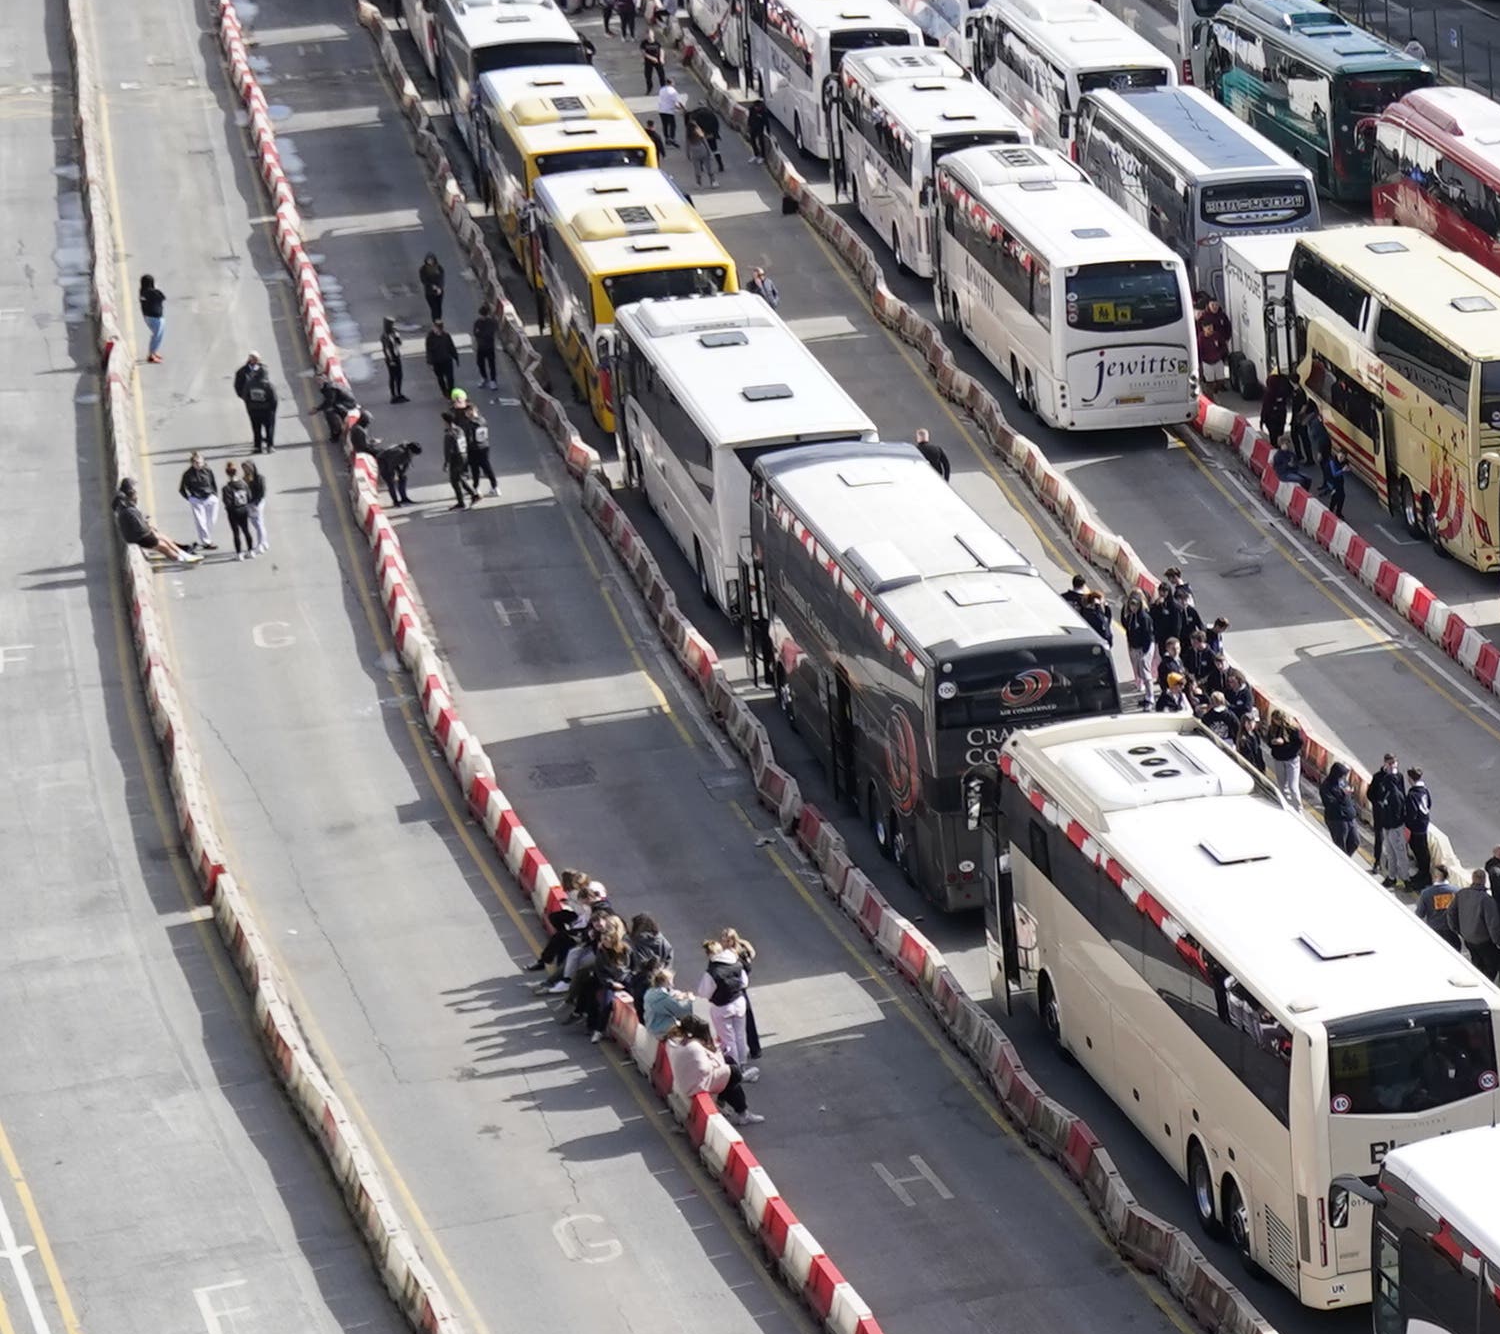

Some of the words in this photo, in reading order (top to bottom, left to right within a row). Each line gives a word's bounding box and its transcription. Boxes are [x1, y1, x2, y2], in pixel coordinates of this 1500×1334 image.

[1081, 351, 1178, 403] jewitts
[869, 1153, 956, 1208] H
[552, 1213, 624, 1264] G
[1332, 1283, 1345, 1294] UK
